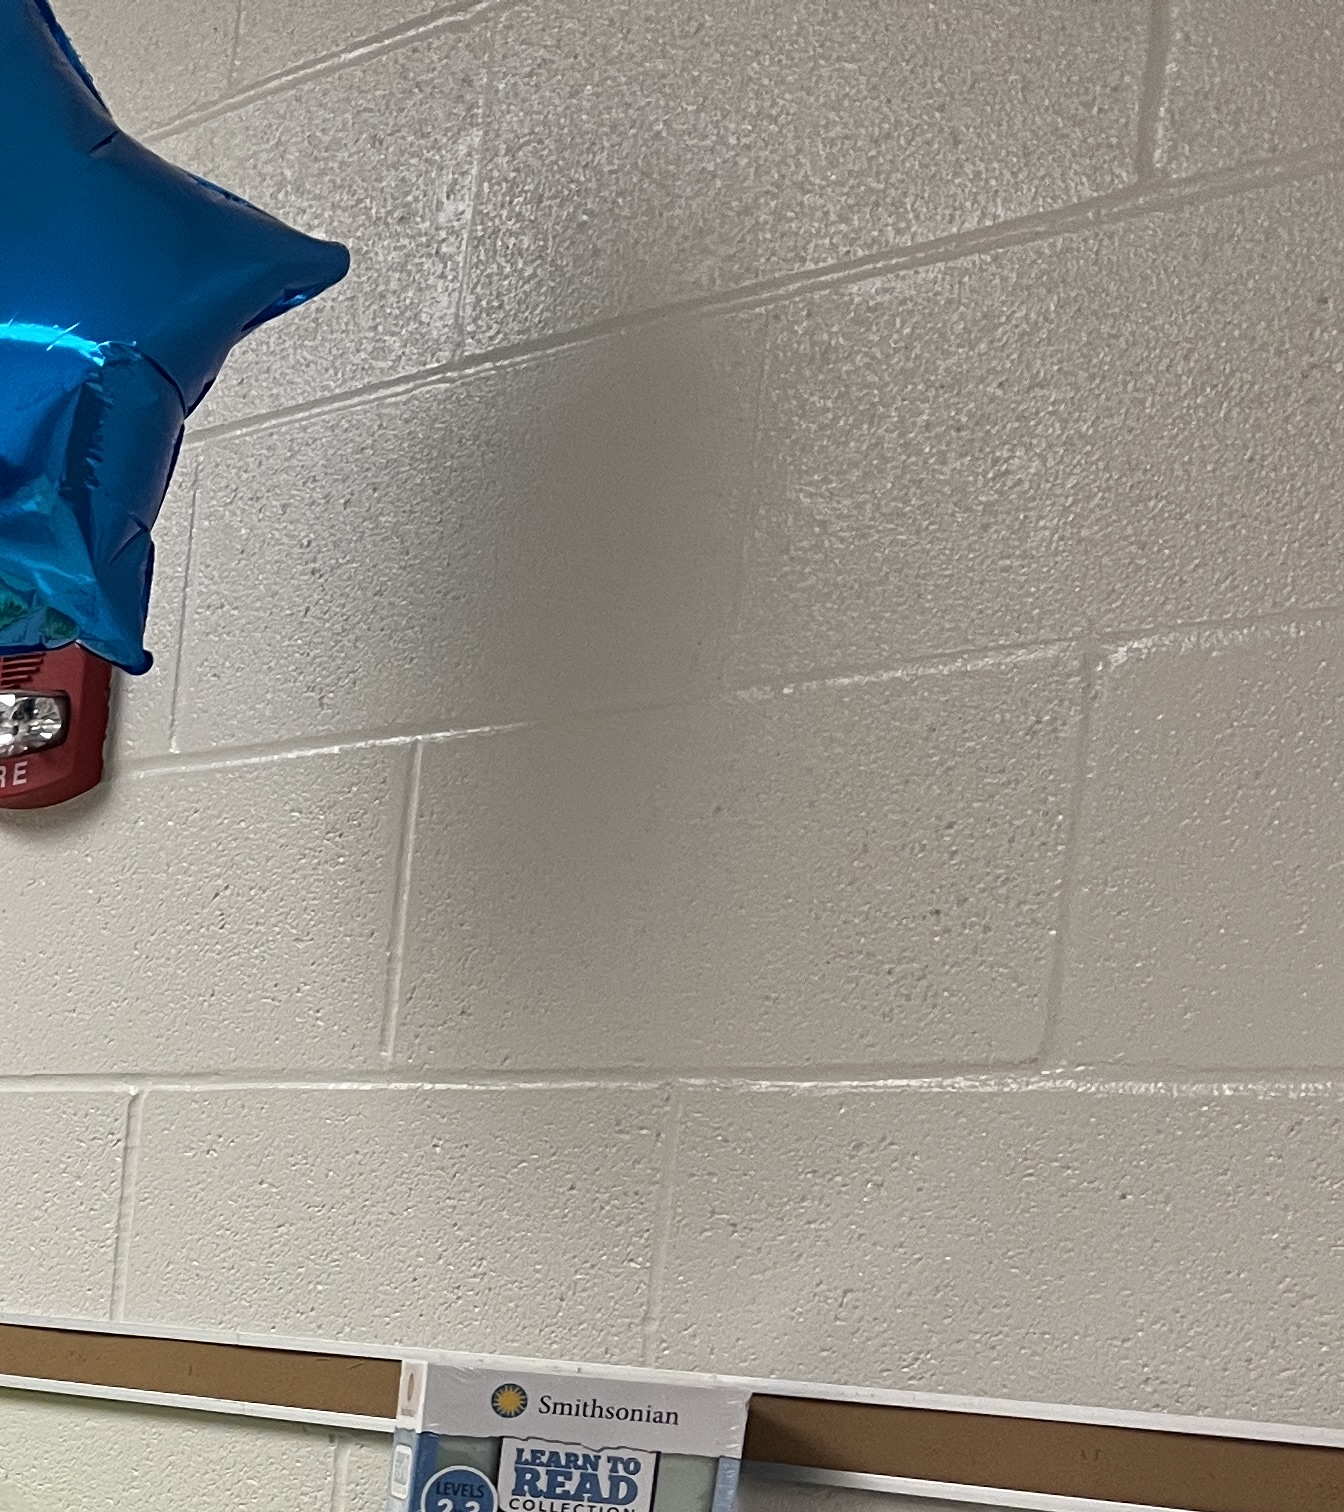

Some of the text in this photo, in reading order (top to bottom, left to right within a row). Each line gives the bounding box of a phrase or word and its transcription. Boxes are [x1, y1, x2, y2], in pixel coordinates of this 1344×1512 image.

[538, 1395, 679, 1427] Smithsonian
[514, 1447, 642, 1476] LEARN TO
[435, 1482, 485, 1500] LEVELS
[512, 1472, 640, 1506] READ
